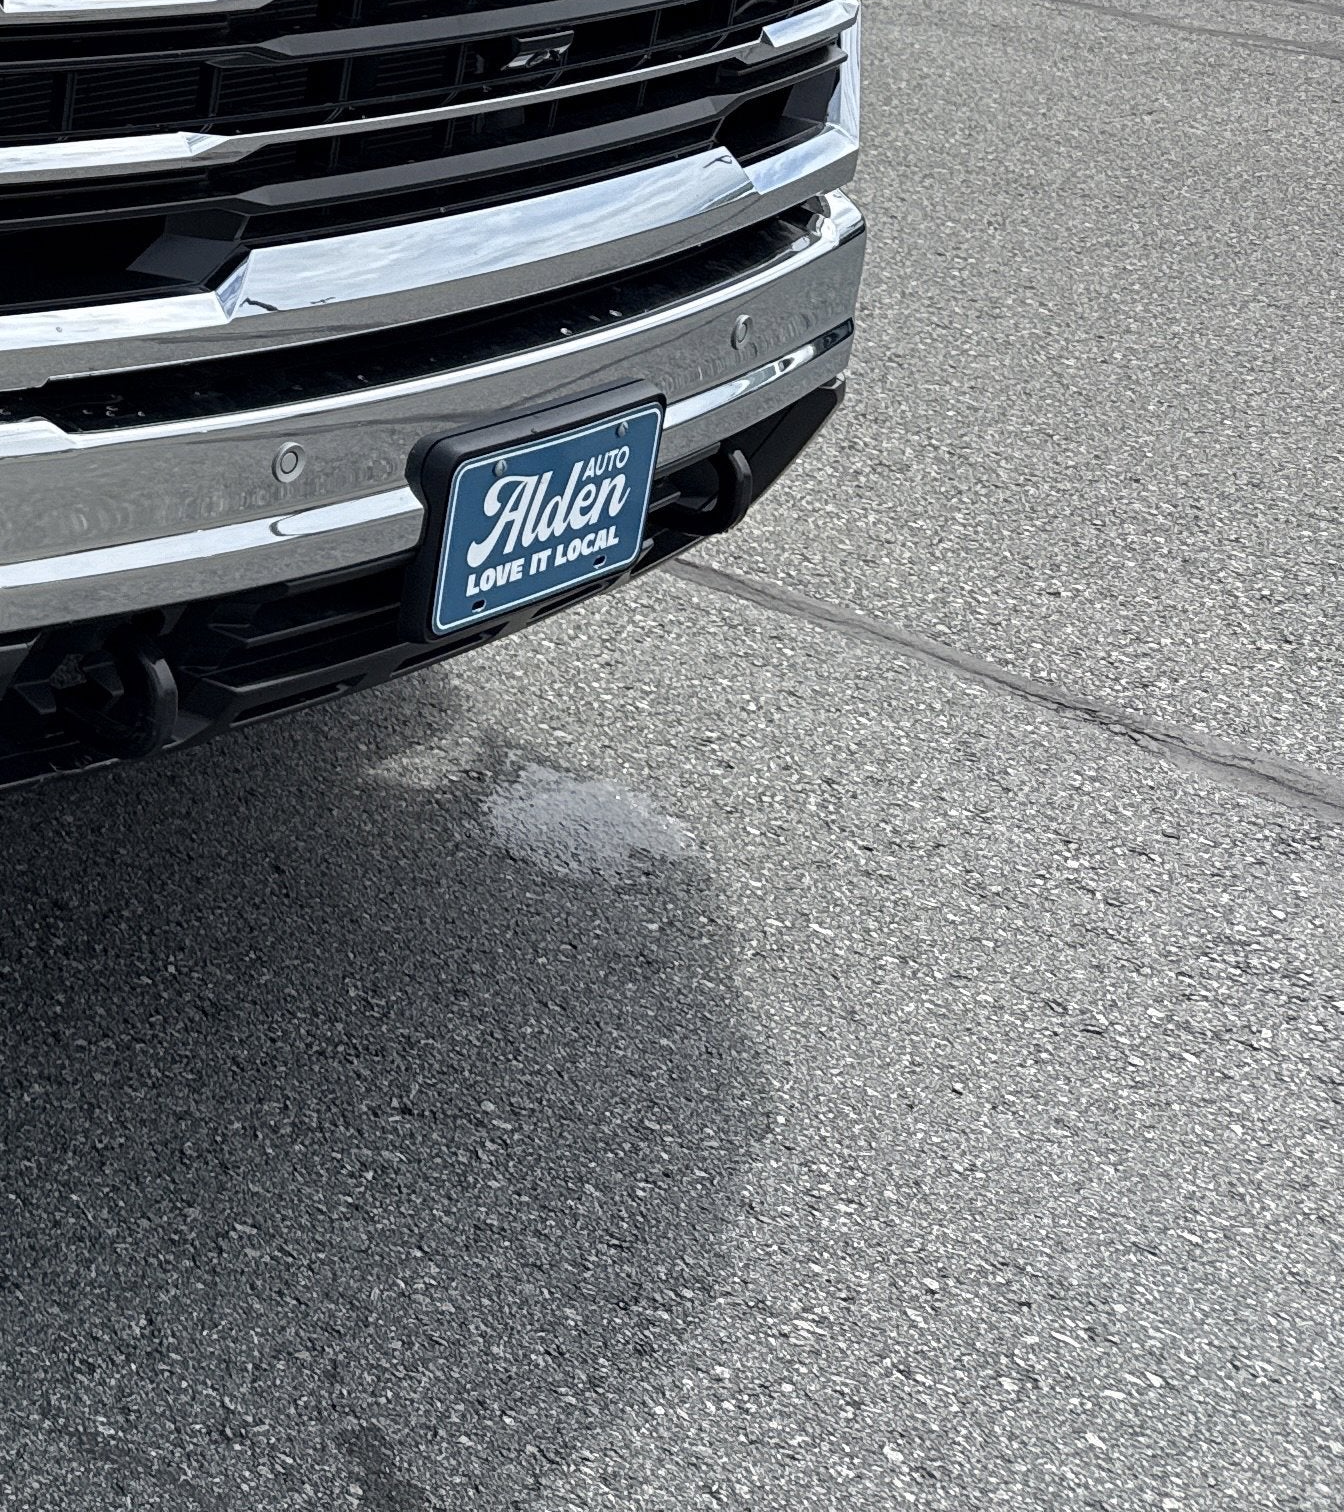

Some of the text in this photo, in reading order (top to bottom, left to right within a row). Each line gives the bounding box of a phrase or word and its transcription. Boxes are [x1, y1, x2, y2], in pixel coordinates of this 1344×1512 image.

[582, 445, 630, 481] AUTO
[466, 460, 631, 568] Alden
[465, 525, 620, 597] LOVE IT LOCAL
